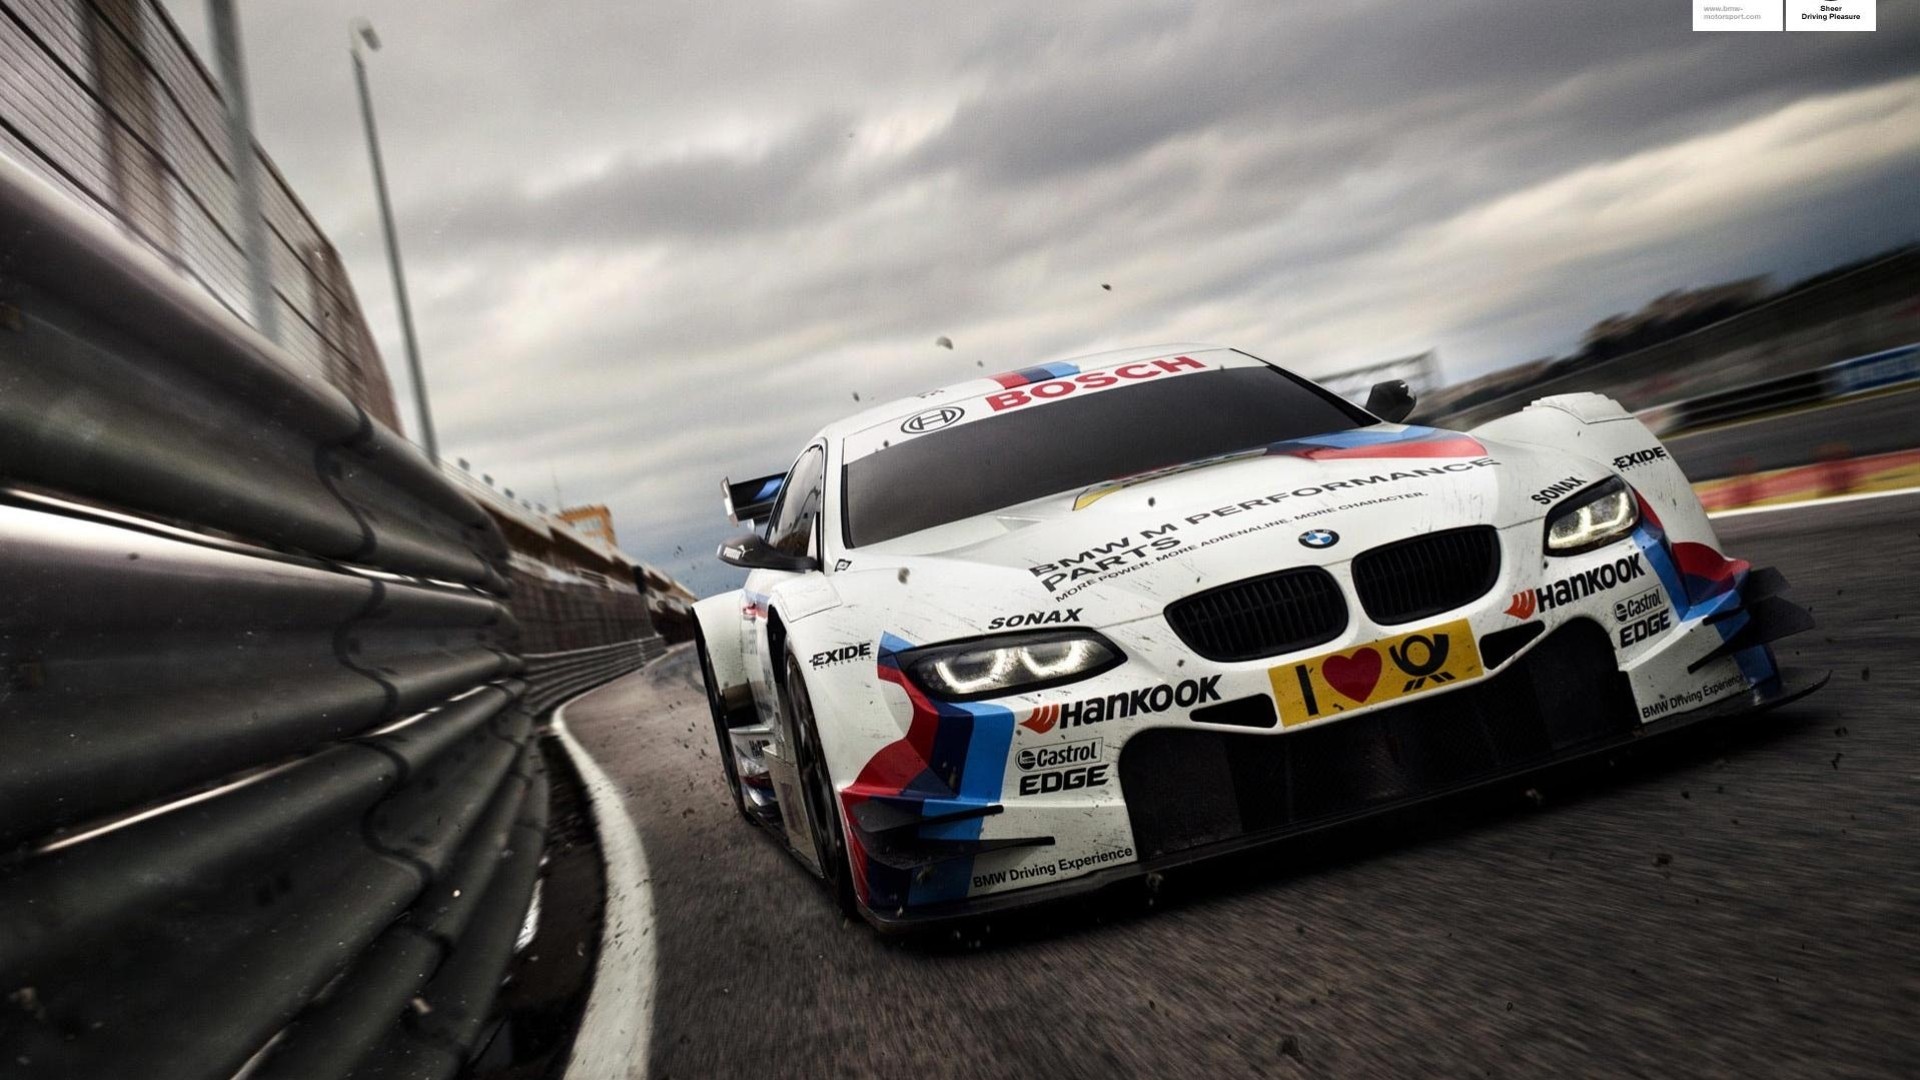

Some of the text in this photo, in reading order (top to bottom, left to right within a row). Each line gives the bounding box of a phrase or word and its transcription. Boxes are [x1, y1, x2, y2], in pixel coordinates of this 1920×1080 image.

[984, 356, 1207, 412] BOSCH
[1613, 446, 1666, 468] EXIDE
[1531, 476, 1587, 505] SONAX
[1028, 457, 1501, 577] BMW M PERFORMANCE
[1041, 537, 1182, 592] PARTS
[1055, 578, 1097, 602] MORE
[1156, 545, 1198, 562] MORE
[1294, 507, 1335, 521] MORE
[1627, 588, 1662, 617] Castrol
[988, 608, 1083, 630] SONAX
[1619, 608, 1671, 648] EDGE
[809, 642, 871, 667] EXIDE
[1642, 699, 1669, 718] BMW
[1669, 690, 1703, 709] Driving
[1036, 742, 1097, 768] Castrol
[1019, 764, 1109, 796] EDGE
[973, 847, 1132, 888] BMW Driving Experience
